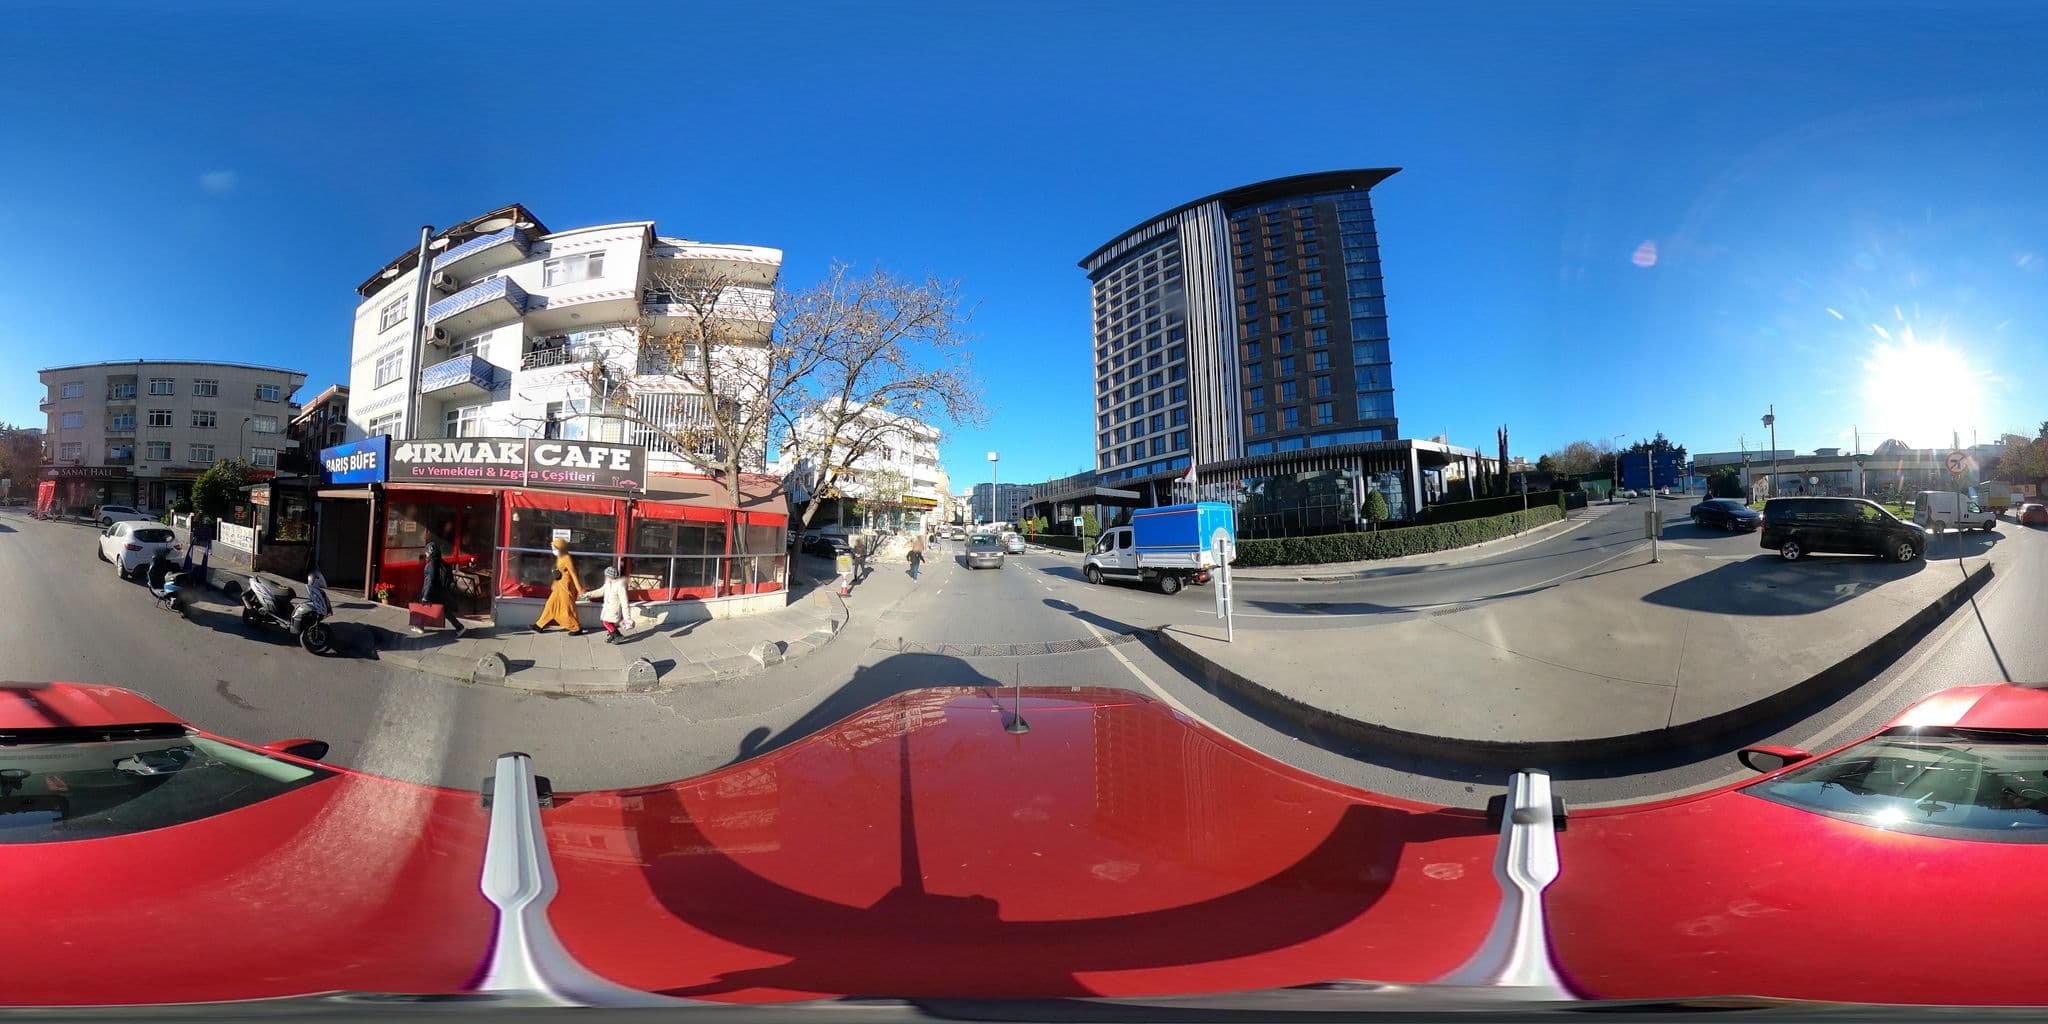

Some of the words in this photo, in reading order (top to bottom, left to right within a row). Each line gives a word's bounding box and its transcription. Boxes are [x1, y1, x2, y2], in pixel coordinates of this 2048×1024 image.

[326, 456, 349, 475] BARIŞ
[350, 451, 376, 470] BÜFE
[412, 442, 524, 464] IRMAK
[534, 444, 631, 471] CAFE
[412, 466, 425, 475] Ev
[428, 467, 483, 477] Yemekleri
[486, 467, 496, 477] &
[541, 469, 595, 482] Çeşitleri
